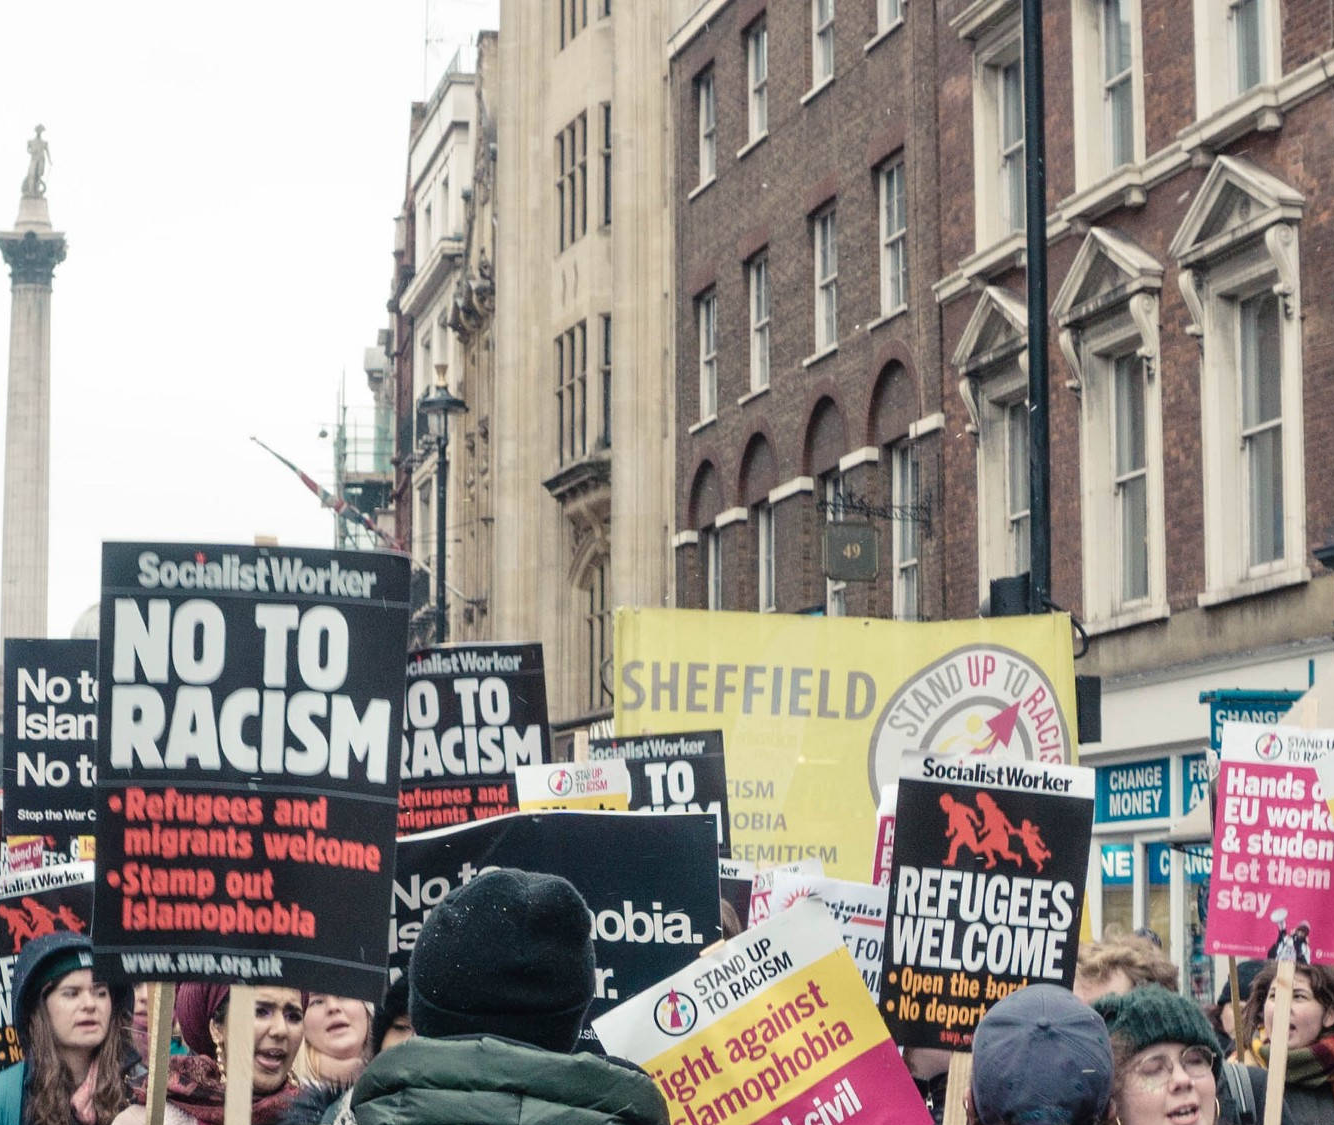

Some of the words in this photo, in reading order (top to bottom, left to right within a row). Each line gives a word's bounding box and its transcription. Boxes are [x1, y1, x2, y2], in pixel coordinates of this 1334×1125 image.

[843, 542, 861, 560] 49
[112, 598, 227, 686] NO
[255, 602, 350, 693] TO
[16, 668, 71, 704] No
[453, 677, 511, 727] TO
[621, 660, 877, 721] SHEFFIELD
[888, 662, 964, 738] STAND
[967, 655, 996, 688] UP
[1003, 659, 1031, 699] TO
[110, 685, 392, 785] RACISM
[1288, 736, 1323, 749] STAND
[16, 752, 71, 788] No
[644, 760, 696, 805] TO
[1109, 766, 1162, 791] CHANGE
[1226, 767, 1307, 800] Hands
[124, 787, 264, 826] Refugees
[273, 795, 329, 830] and
[477, 783, 509, 802] and
[1109, 790, 1162, 817] MONEY
[1224, 796, 1260, 825] EU
[17, 809, 42, 826] Stop
[43, 809, 62, 822] the
[63, 810, 86, 823] War
[123, 825, 254, 861] migrants
[264, 831, 382, 874] welcome
[1221, 825, 1241, 855] &
[121, 863, 217, 900] Stamp
[225, 867, 275, 900] out
[1219, 855, 1261, 884] Let
[1267, 858, 1331, 889] them
[390, 874, 451, 915] No
[894, 865, 1075, 932] REFUGEES
[1216, 885, 1272, 919] stay
[122, 898, 316, 938] Islamophobia
[121, 952, 283, 978] www.swp.org.uk
[892, 914, 1068, 980] WELCOME
[693, 949, 746, 997] STAND
[746, 938, 772, 963] UP
[703, 990, 729, 1017] TO
[729, 950, 793, 1001] RACISM
[901, 969, 943, 996] Open
[950, 972, 980, 998] the
[725, 979, 829, 1063] against
[898, 998, 920, 1021] No
